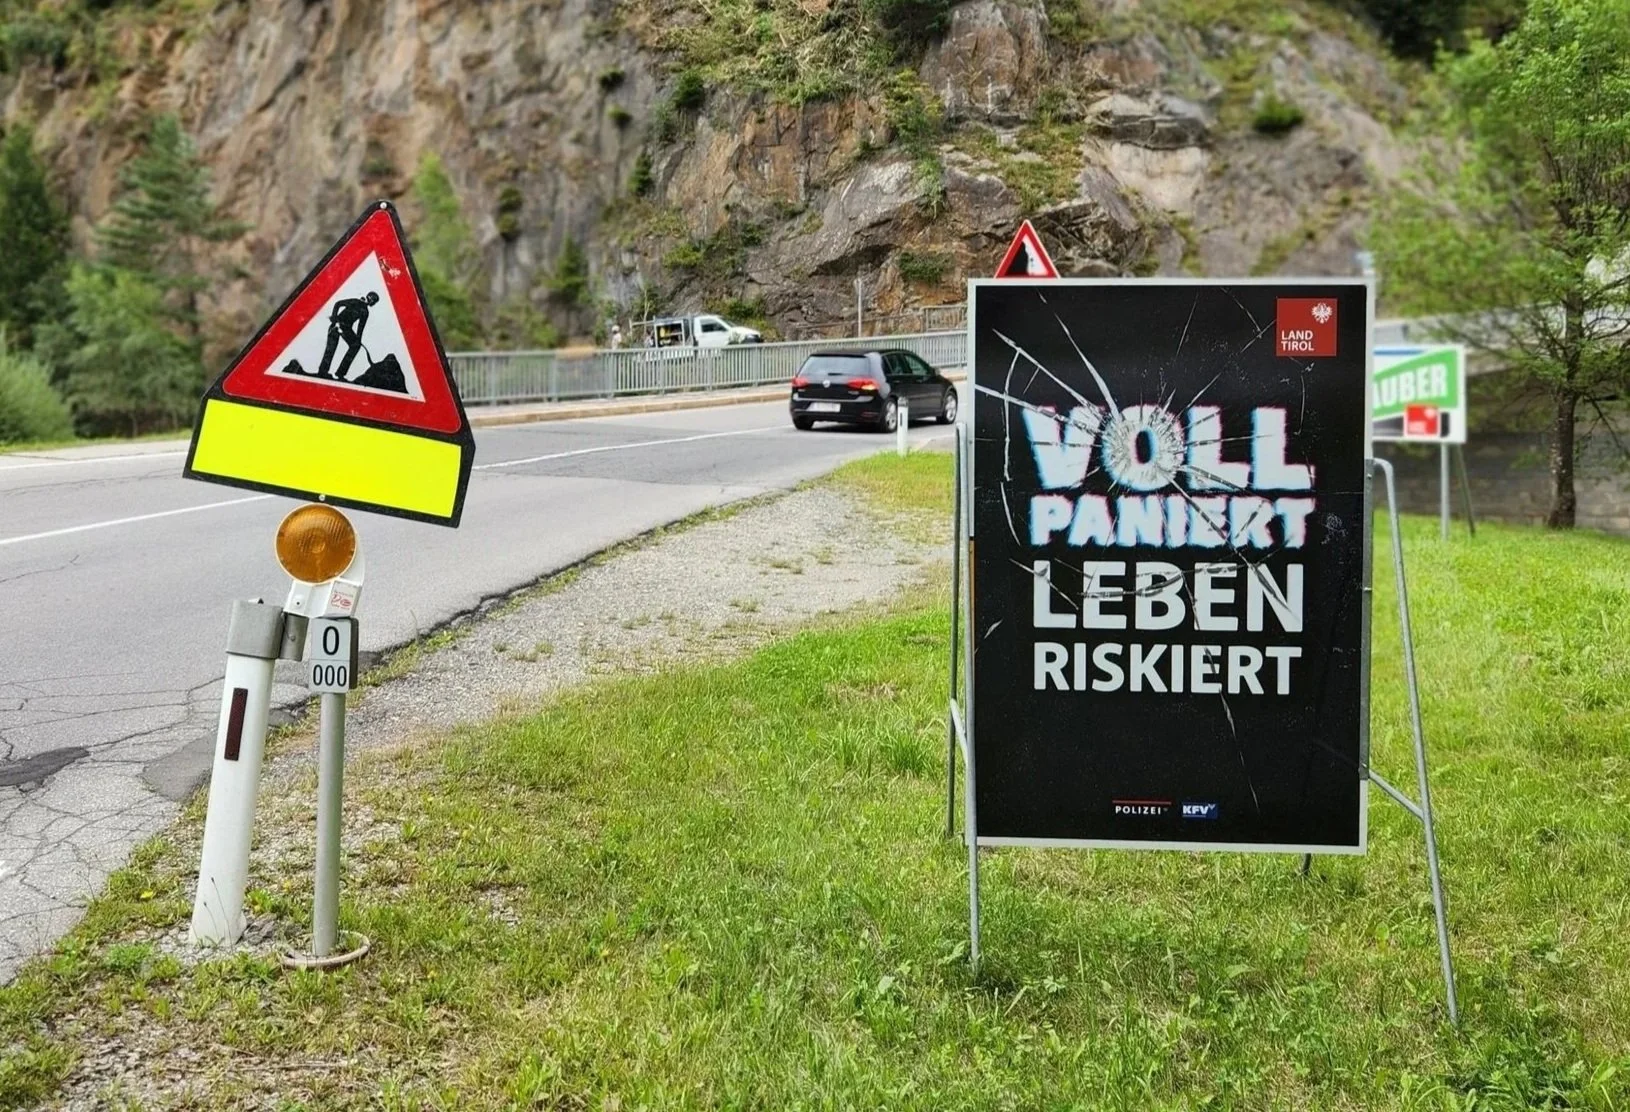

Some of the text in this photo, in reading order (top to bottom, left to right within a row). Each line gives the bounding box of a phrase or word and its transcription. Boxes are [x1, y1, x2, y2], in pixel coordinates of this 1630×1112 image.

[1280, 341, 1315, 351] TIROL
[1281, 330, 1313, 341] LAND
[1023, 404, 1315, 491] VOLL
[1030, 495, 1316, 548] PANIERT
[1033, 560, 1304, 632] LEBEN
[322, 626, 340, 656] 0
[313, 664, 347, 687] 000
[1034, 642, 1302, 695] RISKIERT
[1115, 805, 1209, 815] POLIZEI KFV
